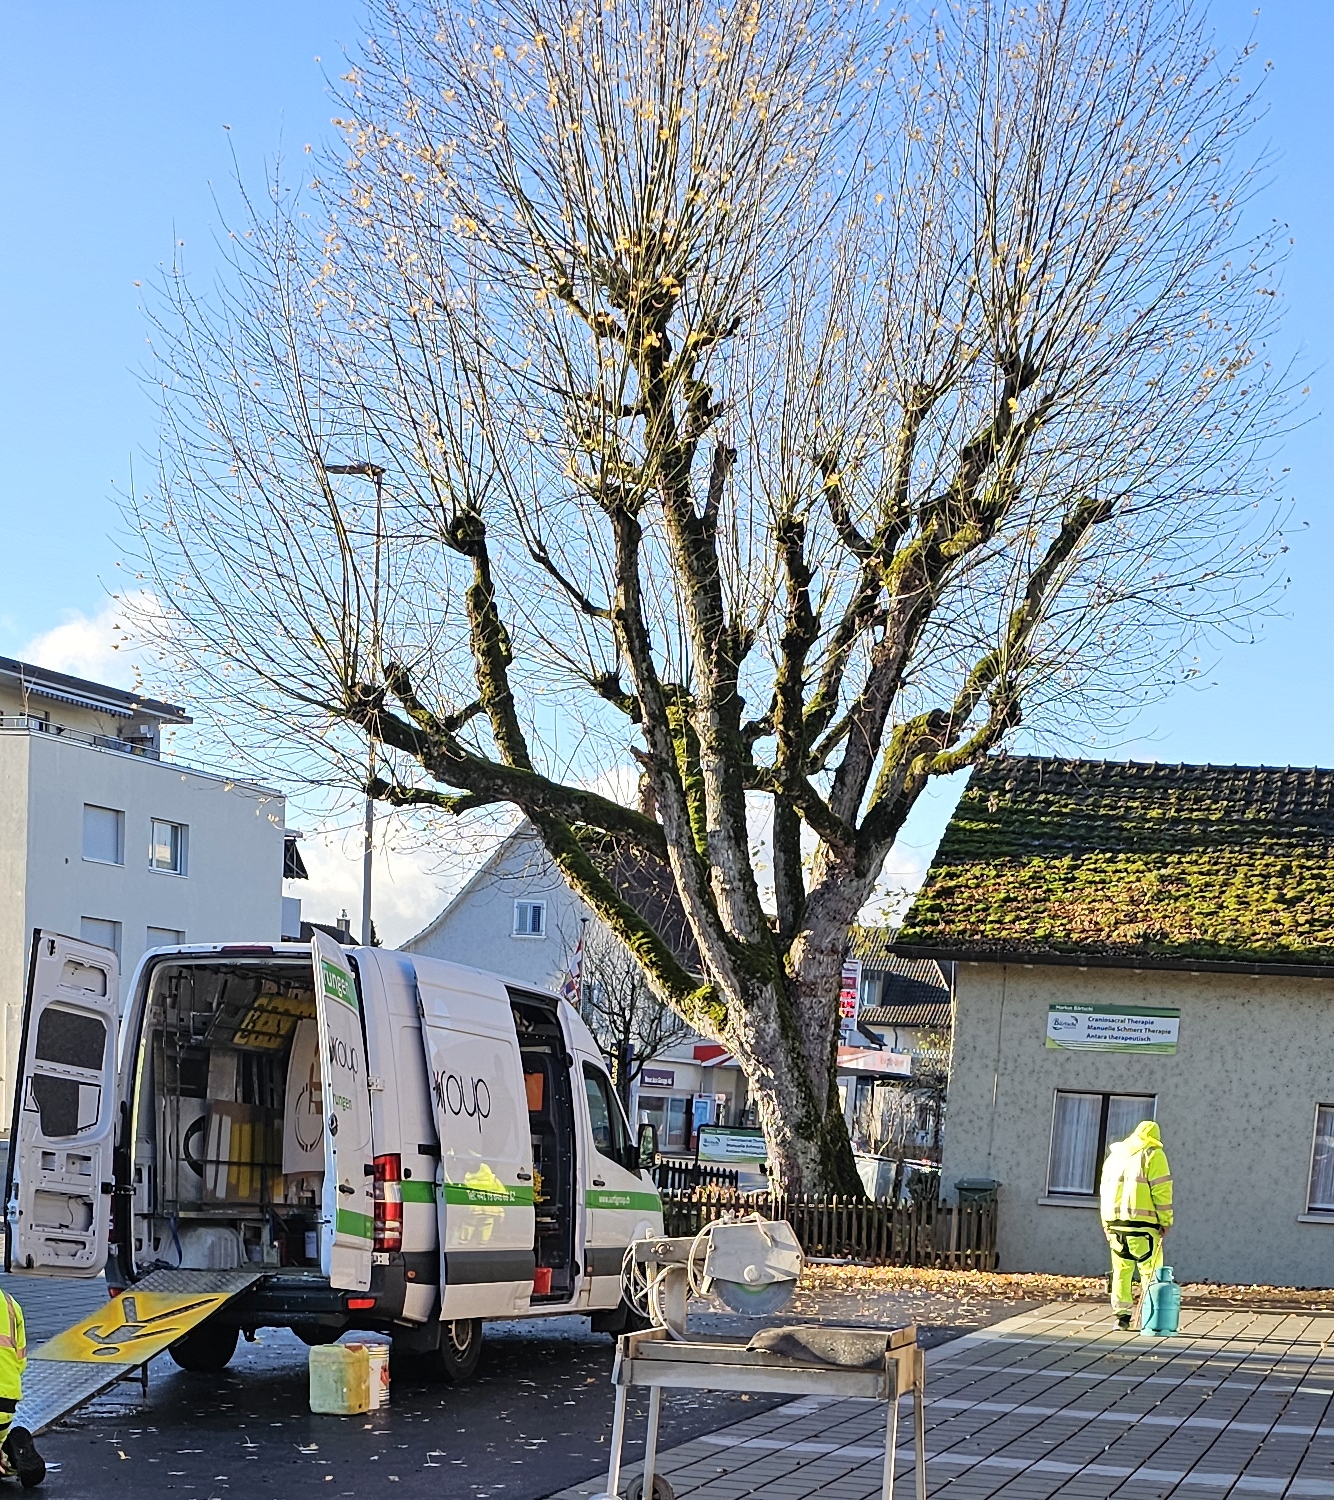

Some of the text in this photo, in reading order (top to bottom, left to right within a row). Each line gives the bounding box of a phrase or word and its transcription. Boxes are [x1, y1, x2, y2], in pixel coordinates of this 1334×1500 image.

[1087, 1016, 1155, 1027] Craniosacral Therapie
[1144, 1028, 1172, 1036] Therapie
[1086, 1033, 1151, 1042] Antara therapeutisch
